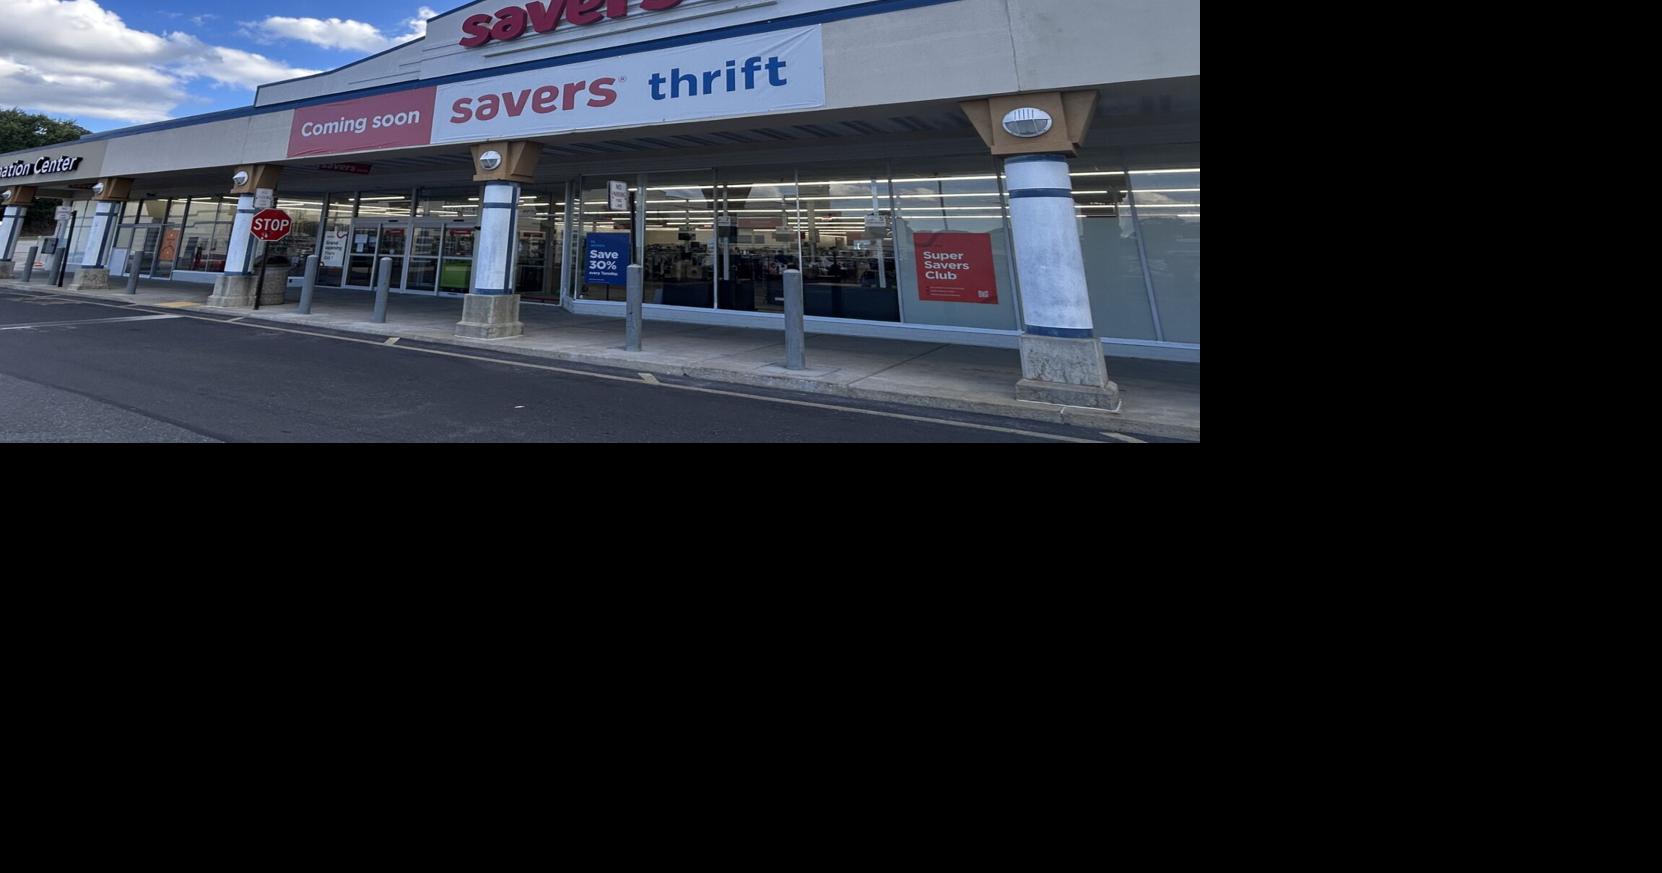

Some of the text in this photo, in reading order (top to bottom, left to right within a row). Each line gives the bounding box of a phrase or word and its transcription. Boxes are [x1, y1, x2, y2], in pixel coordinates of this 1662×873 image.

[450, 56, 787, 124] savers thrift
[301, 110, 420, 137] Coming soon
[0, 156, 78, 178] ation Center
[253, 218, 290, 231] STOP
[590, 250, 619, 259] Save
[923, 251, 964, 261] Super
[589, 260, 617, 270] 30%
[924, 260, 970, 270] Savers
[925, 271, 957, 280] Club
